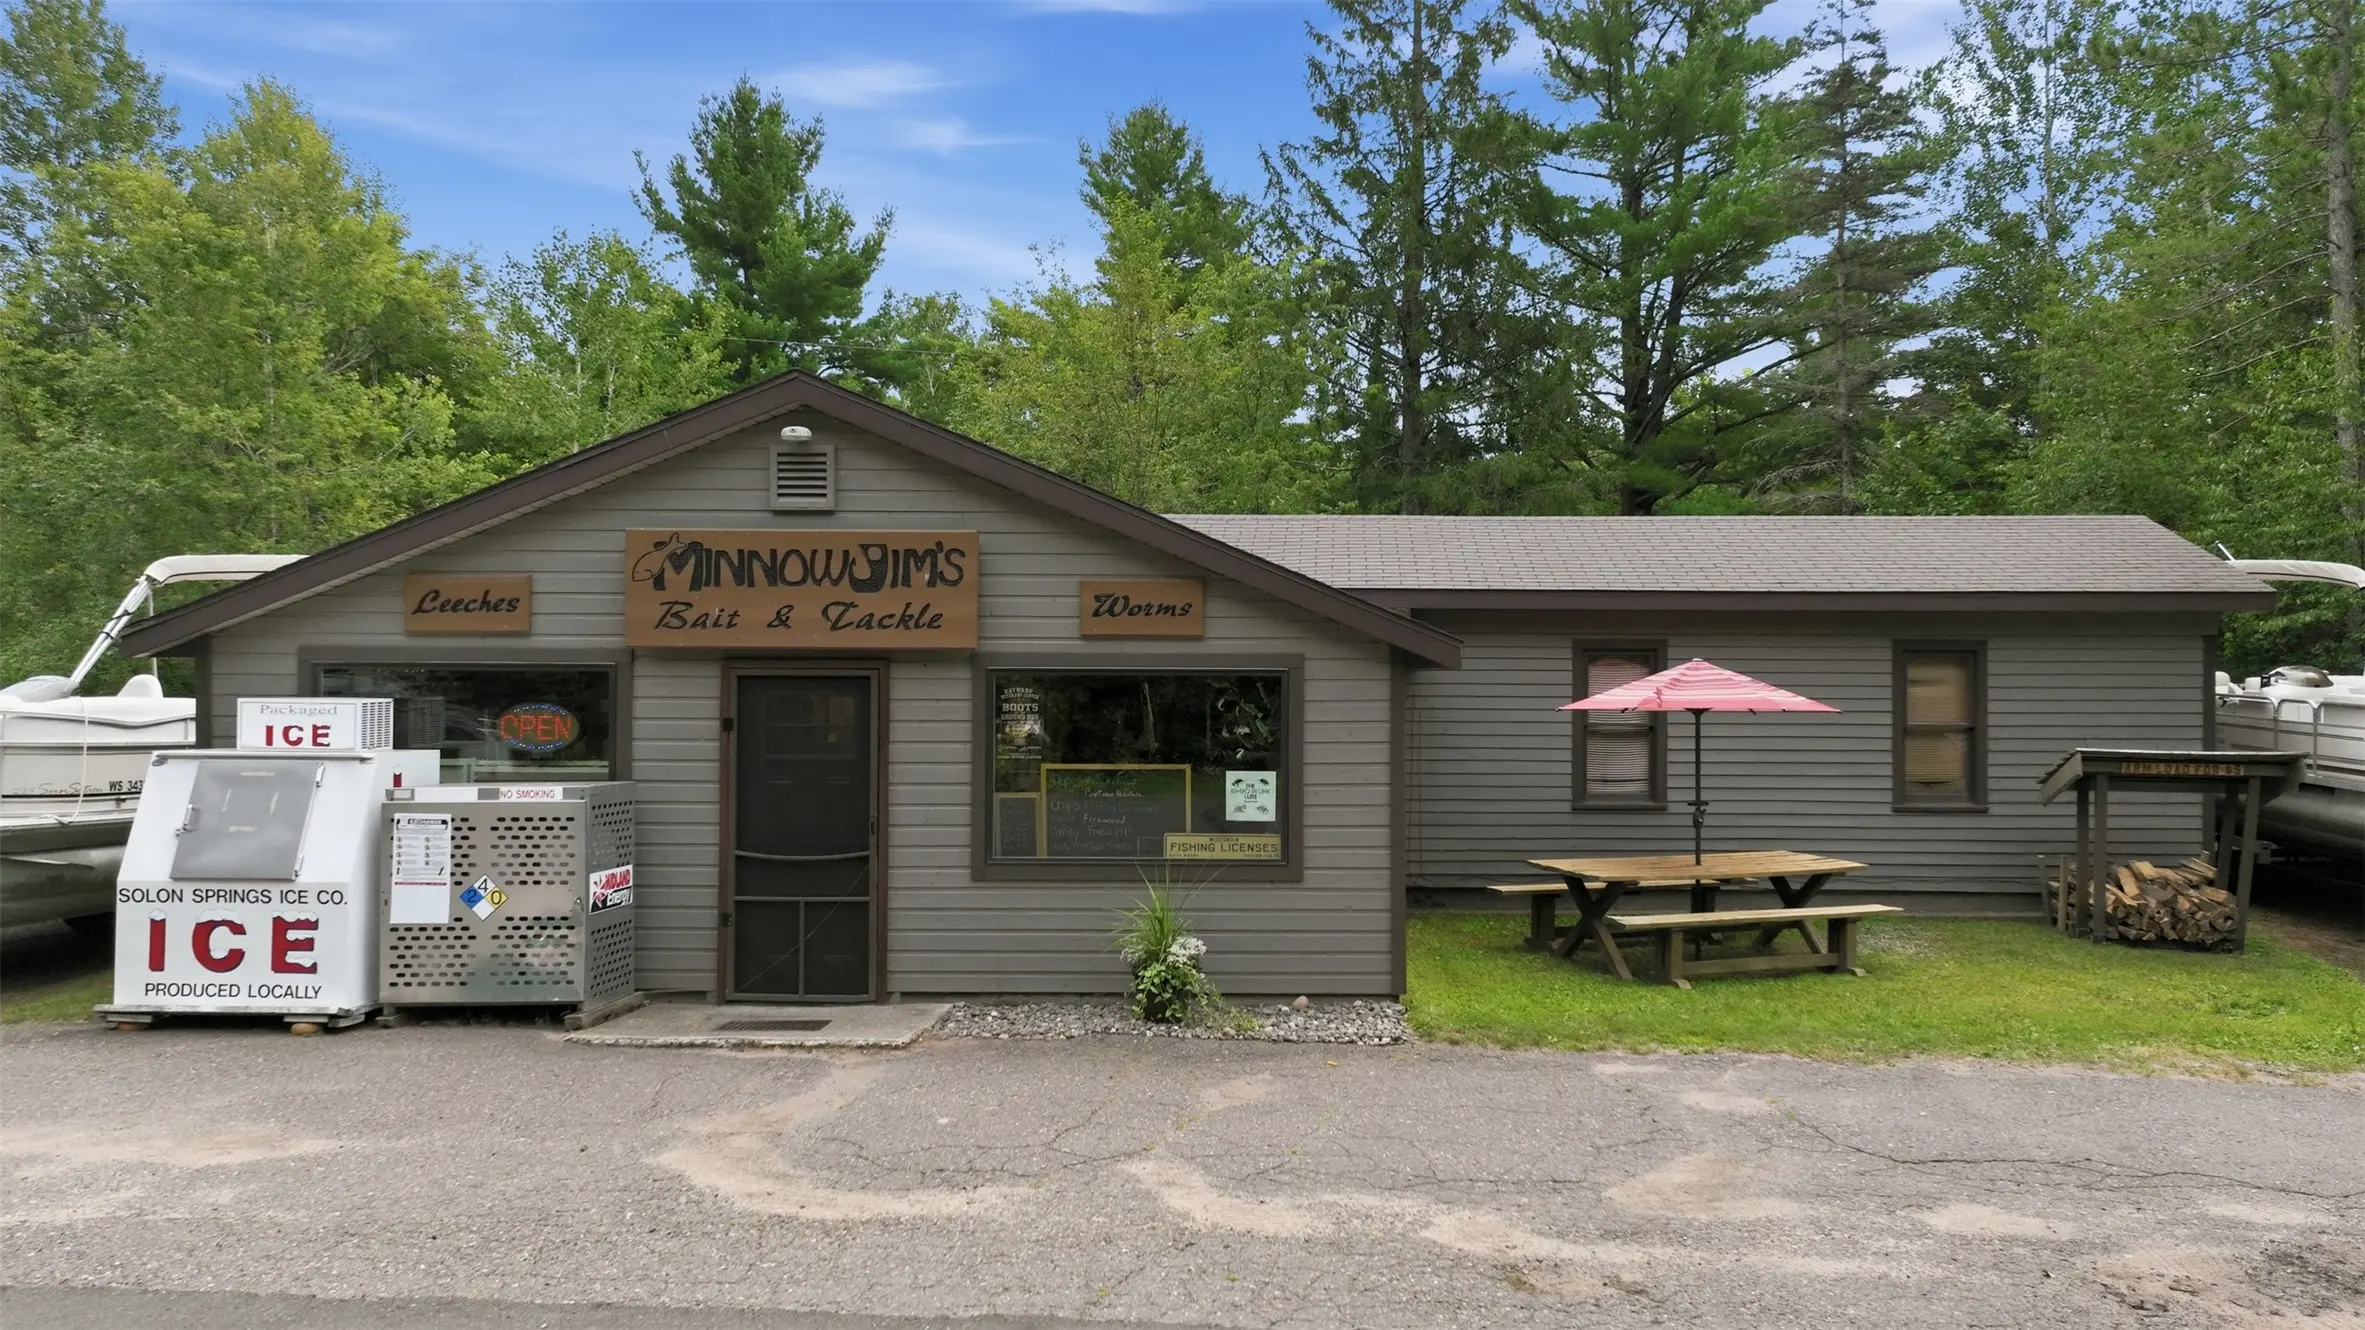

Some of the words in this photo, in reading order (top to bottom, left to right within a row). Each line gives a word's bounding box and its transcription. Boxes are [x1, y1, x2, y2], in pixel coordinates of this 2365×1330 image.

[652, 541, 849, 592] MINNOW
[411, 589, 520, 615] Leeches
[1092, 593, 1193, 617] Worms
[654, 600, 740, 630] Bait
[767, 605, 794, 629] &
[821, 601, 943, 632] Tackle
[260, 704, 337, 716] Packaged
[1002, 703, 1039, 712] BOOTS
[499, 712, 573, 740] OPEN
[265, 724, 331, 747] ICE
[109, 780, 123, 791] WS
[501, 789, 513, 798] NO
[516, 789, 555, 799] SMOKING
[1170, 842, 1216, 853] FISHING
[1220, 843, 1278, 853] LICENSES
[477, 878, 489, 893] 4
[118, 888, 184, 904] SOLON
[192, 888, 272, 904] SPRINGS
[280, 889, 309, 905] ICE
[317, 890, 348, 905] CO.
[467, 889, 477, 903] 2
[491, 890, 502, 905] 0
[148, 909, 319, 974] ICE
[144, 983, 240, 998] PRODUCED
[248, 984, 322, 999] LOCALLY
